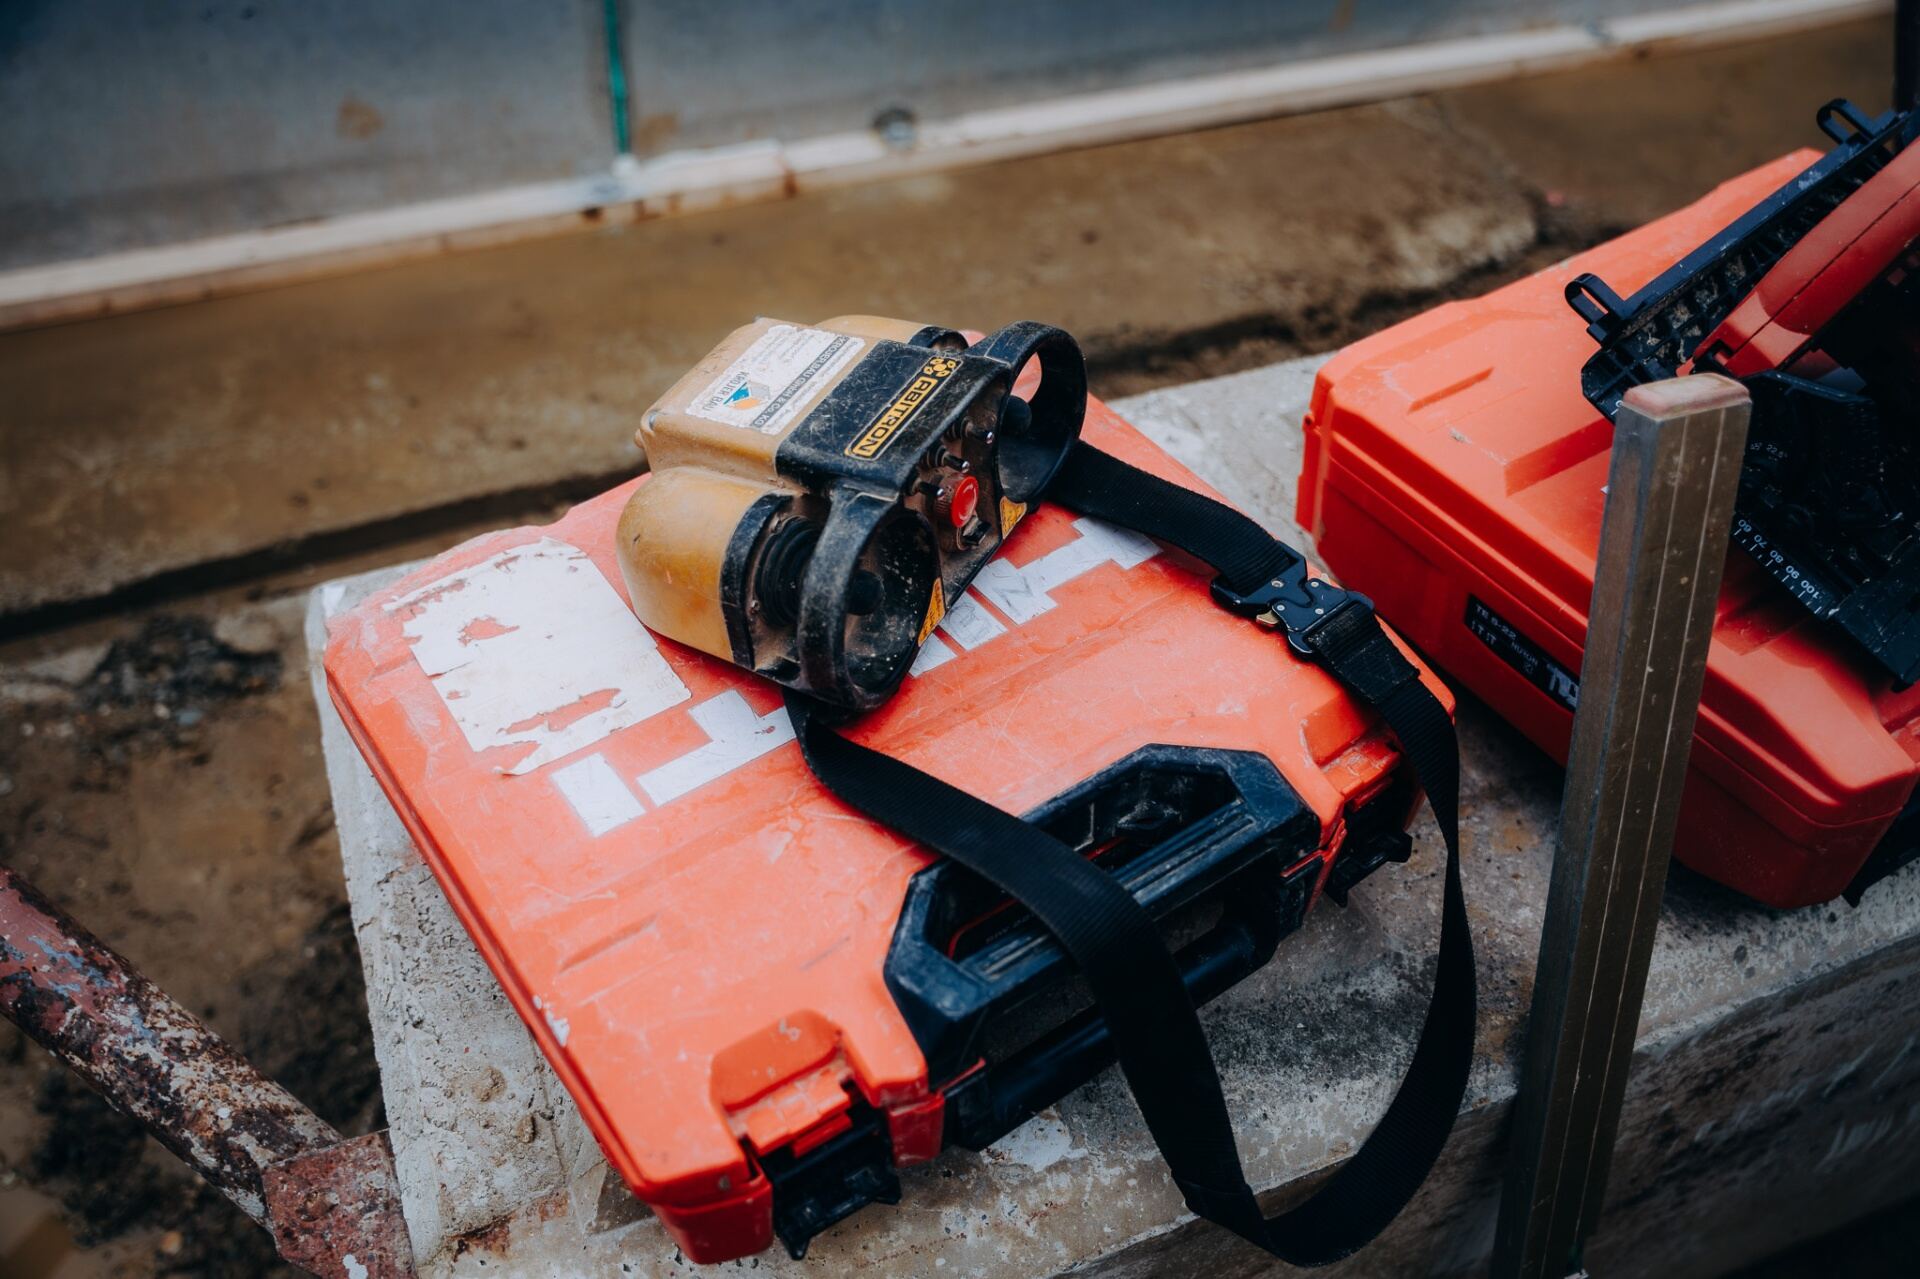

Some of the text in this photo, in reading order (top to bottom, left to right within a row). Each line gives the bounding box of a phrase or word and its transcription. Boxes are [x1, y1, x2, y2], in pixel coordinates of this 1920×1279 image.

[858, 378, 932, 453] ABITRON
[1754, 535, 1767, 548] 70
[1770, 550, 1784, 564] 80
[1786, 565, 1800, 579] 90
[1800, 580, 1820, 599] 100
